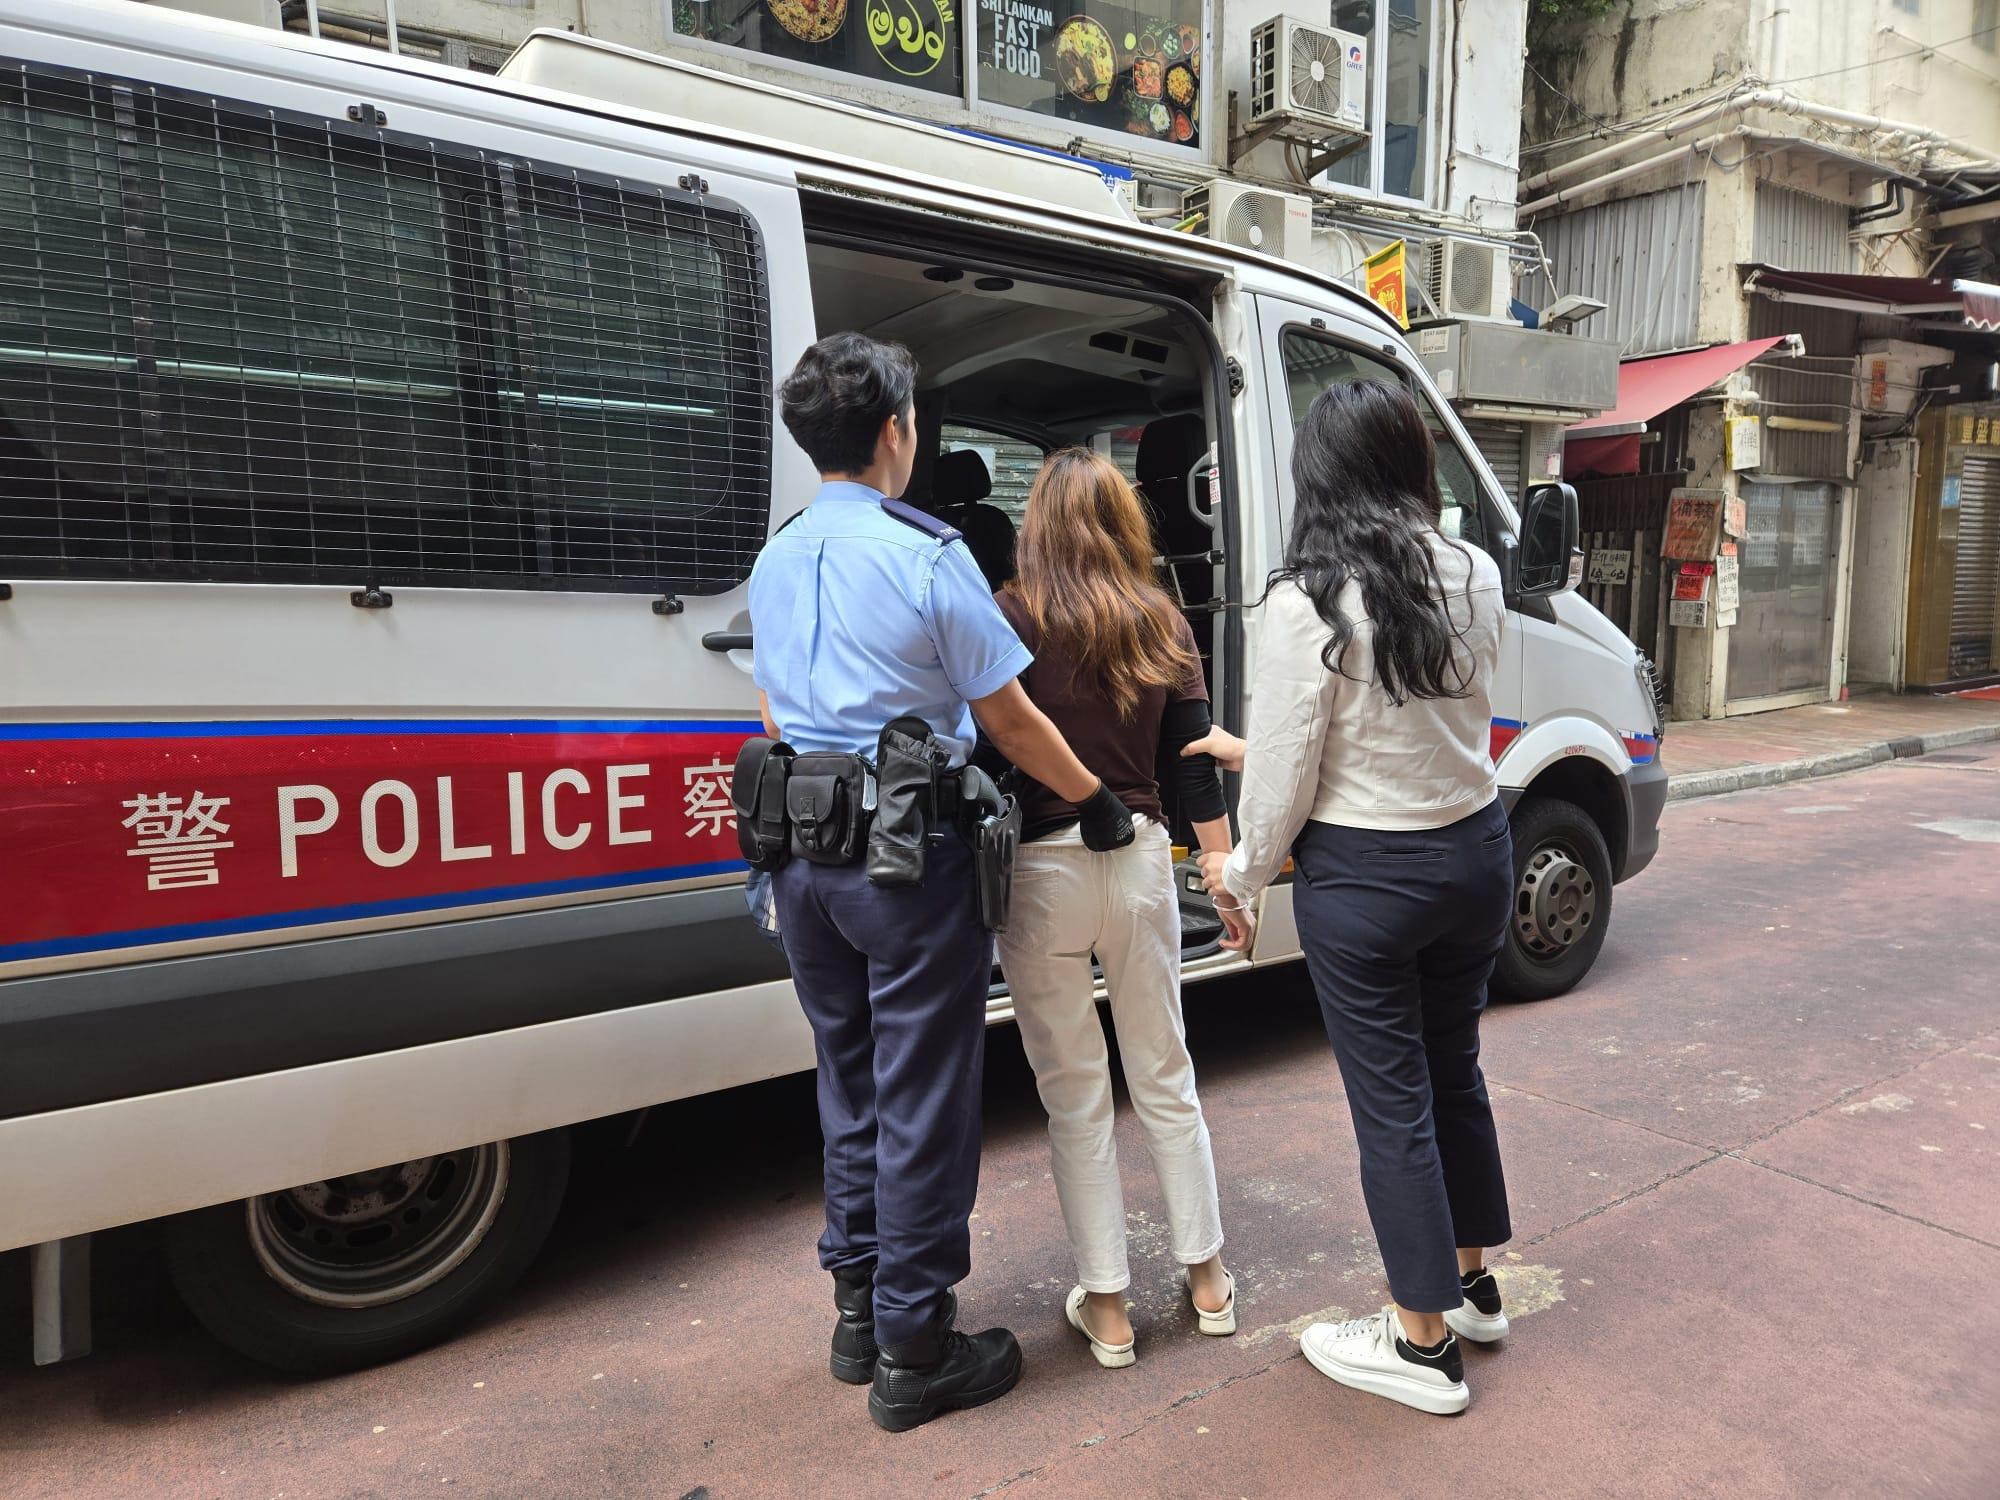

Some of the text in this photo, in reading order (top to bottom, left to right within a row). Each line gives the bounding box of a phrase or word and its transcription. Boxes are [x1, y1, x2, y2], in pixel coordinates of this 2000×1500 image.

[937, 0, 955, 23] AN
[981, 0, 1053, 27] SRI LANKAN
[995, 13, 1040, 50] FAST
[995, 41, 1041, 79] FOOD
[1346, 61, 1365, 72] GREE
[121, 758, 738, 891] 警 POLICE 察
